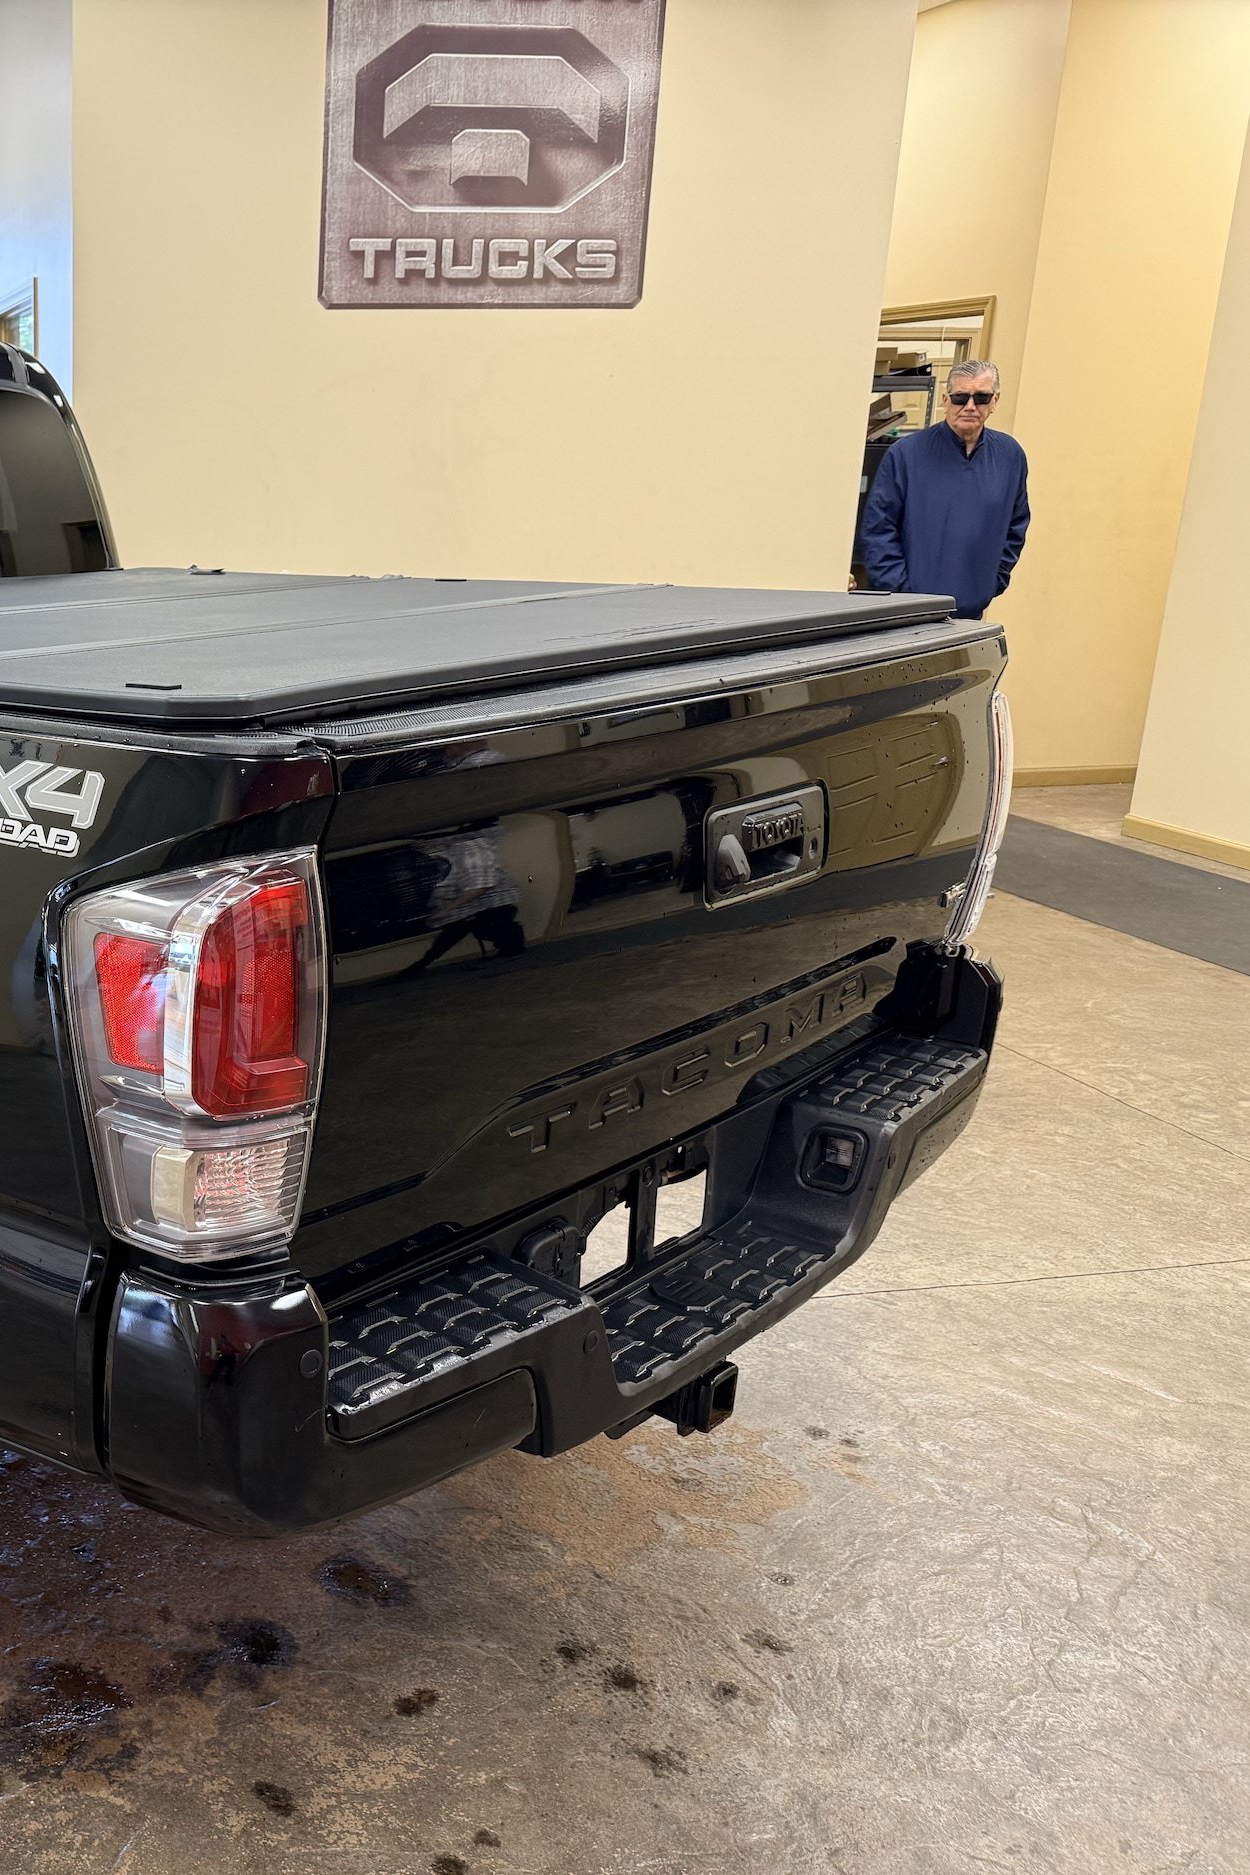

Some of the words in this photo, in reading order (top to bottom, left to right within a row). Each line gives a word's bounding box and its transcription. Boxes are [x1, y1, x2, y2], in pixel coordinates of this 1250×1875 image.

[349, 238, 618, 280] TRUCKS
[754, 811, 805, 848] TOYOTA
[506, 971, 867, 1154] TACOMA
